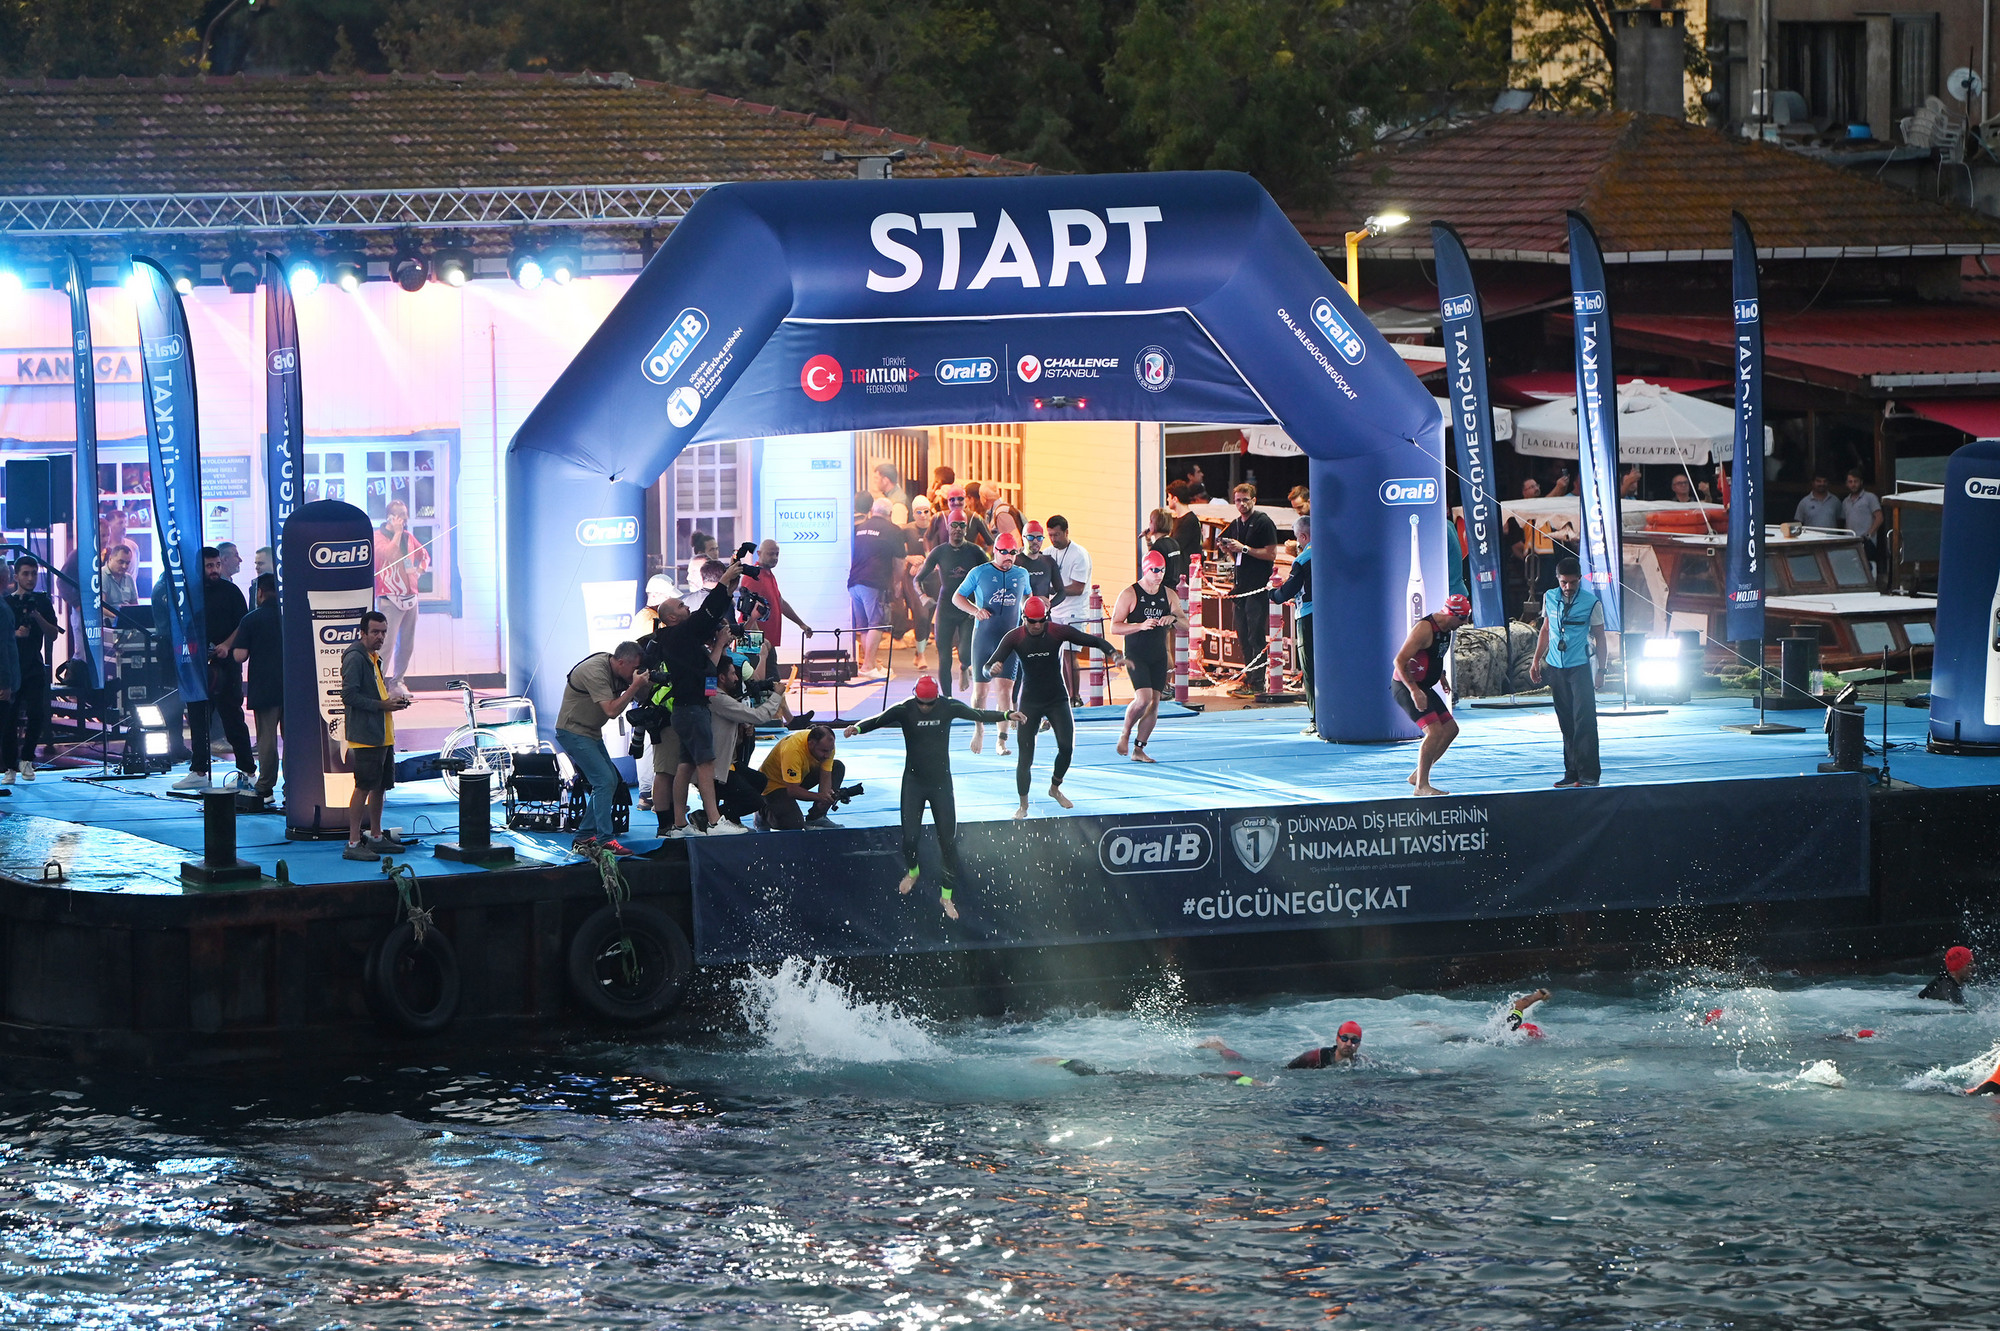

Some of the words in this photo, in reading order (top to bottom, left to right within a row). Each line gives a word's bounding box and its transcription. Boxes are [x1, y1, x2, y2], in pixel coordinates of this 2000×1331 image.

[866, 206, 1163, 293] START
[1316, 305, 1361, 358] Oral-B
[650, 314, 702, 377] Oral-B
[704, 326, 744, 377] HEKİMLERİNİN
[17, 356, 133, 380] KANCA
[882, 356, 906, 366] TÜRKİYE
[1043, 358, 1119, 368] CHALLENGE
[703, 353, 734, 391] NUMARALI
[940, 362, 992, 380] Oral-B
[1044, 368, 1100, 378] ISTANBUL
[866, 384, 908, 394] FEDERASYONU
[1385, 484, 1435, 500] Oral-B
[1969, 481, 2000, 495] Oral
[779, 511, 806, 519] YOLCU
[807, 511, 834, 520] ÇIKIŞI
[582, 522, 636, 541] Oral-B
[316, 545, 369, 564] Oral-B
[323, 627, 362, 642] Oral-
[1243, 818, 1266, 826] Oral-B
[1288, 815, 1357, 833] DÜNYADA
[1363, 810, 1385, 832] DİŞ
[1388, 805, 1488, 828] HEKİMLERİNİN
[1109, 833, 1201, 865] Oral-B
[1288, 843, 1297, 861] 1
[1300, 838, 1396, 860] NUMARALI
[1183, 883, 1411, 919] #GÜCÜNEGÜÇKAT
